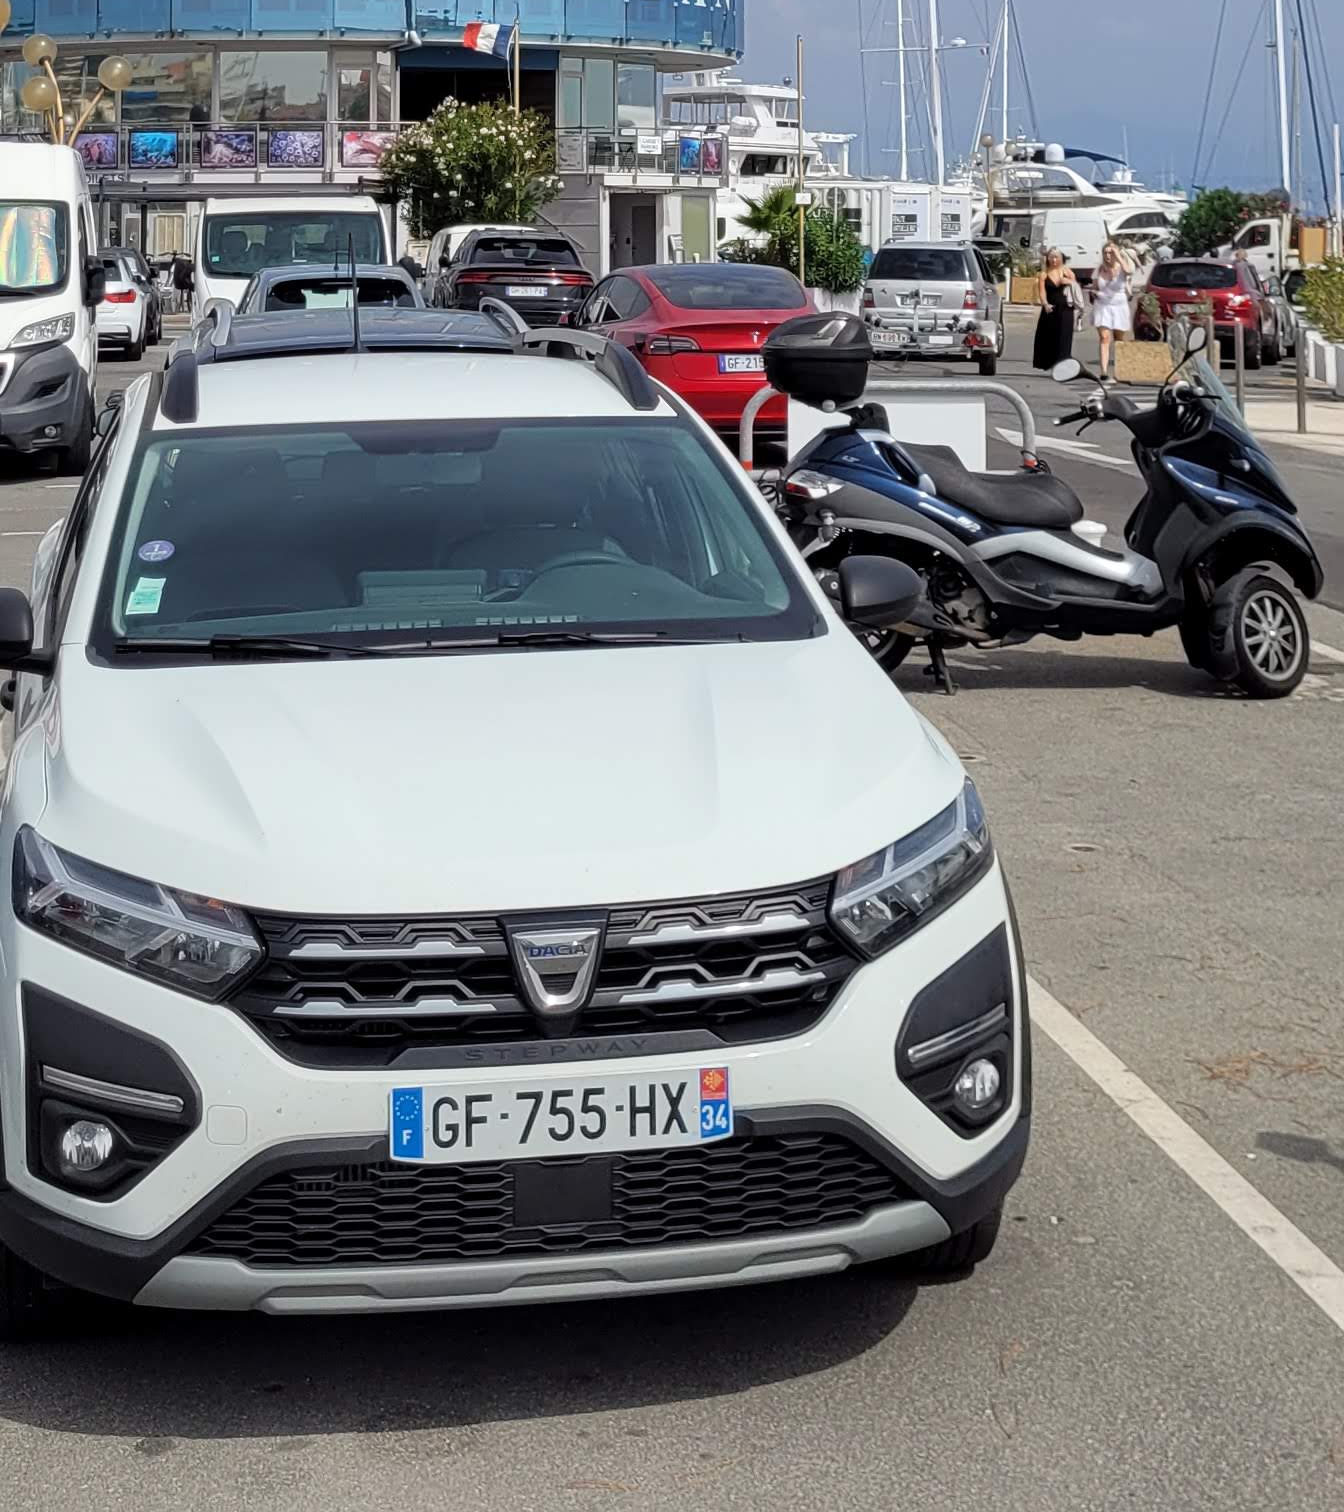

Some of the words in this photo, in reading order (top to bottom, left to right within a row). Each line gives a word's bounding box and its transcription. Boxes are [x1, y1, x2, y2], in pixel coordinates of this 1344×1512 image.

[528, 942, 588, 958] DACIA
[463, 1038, 649, 1061] STEPWAY
[401, 1129, 413, 1147] F
[431, 1080, 689, 1149] GF-755-HX
[702, 1104, 728, 1130] 34
